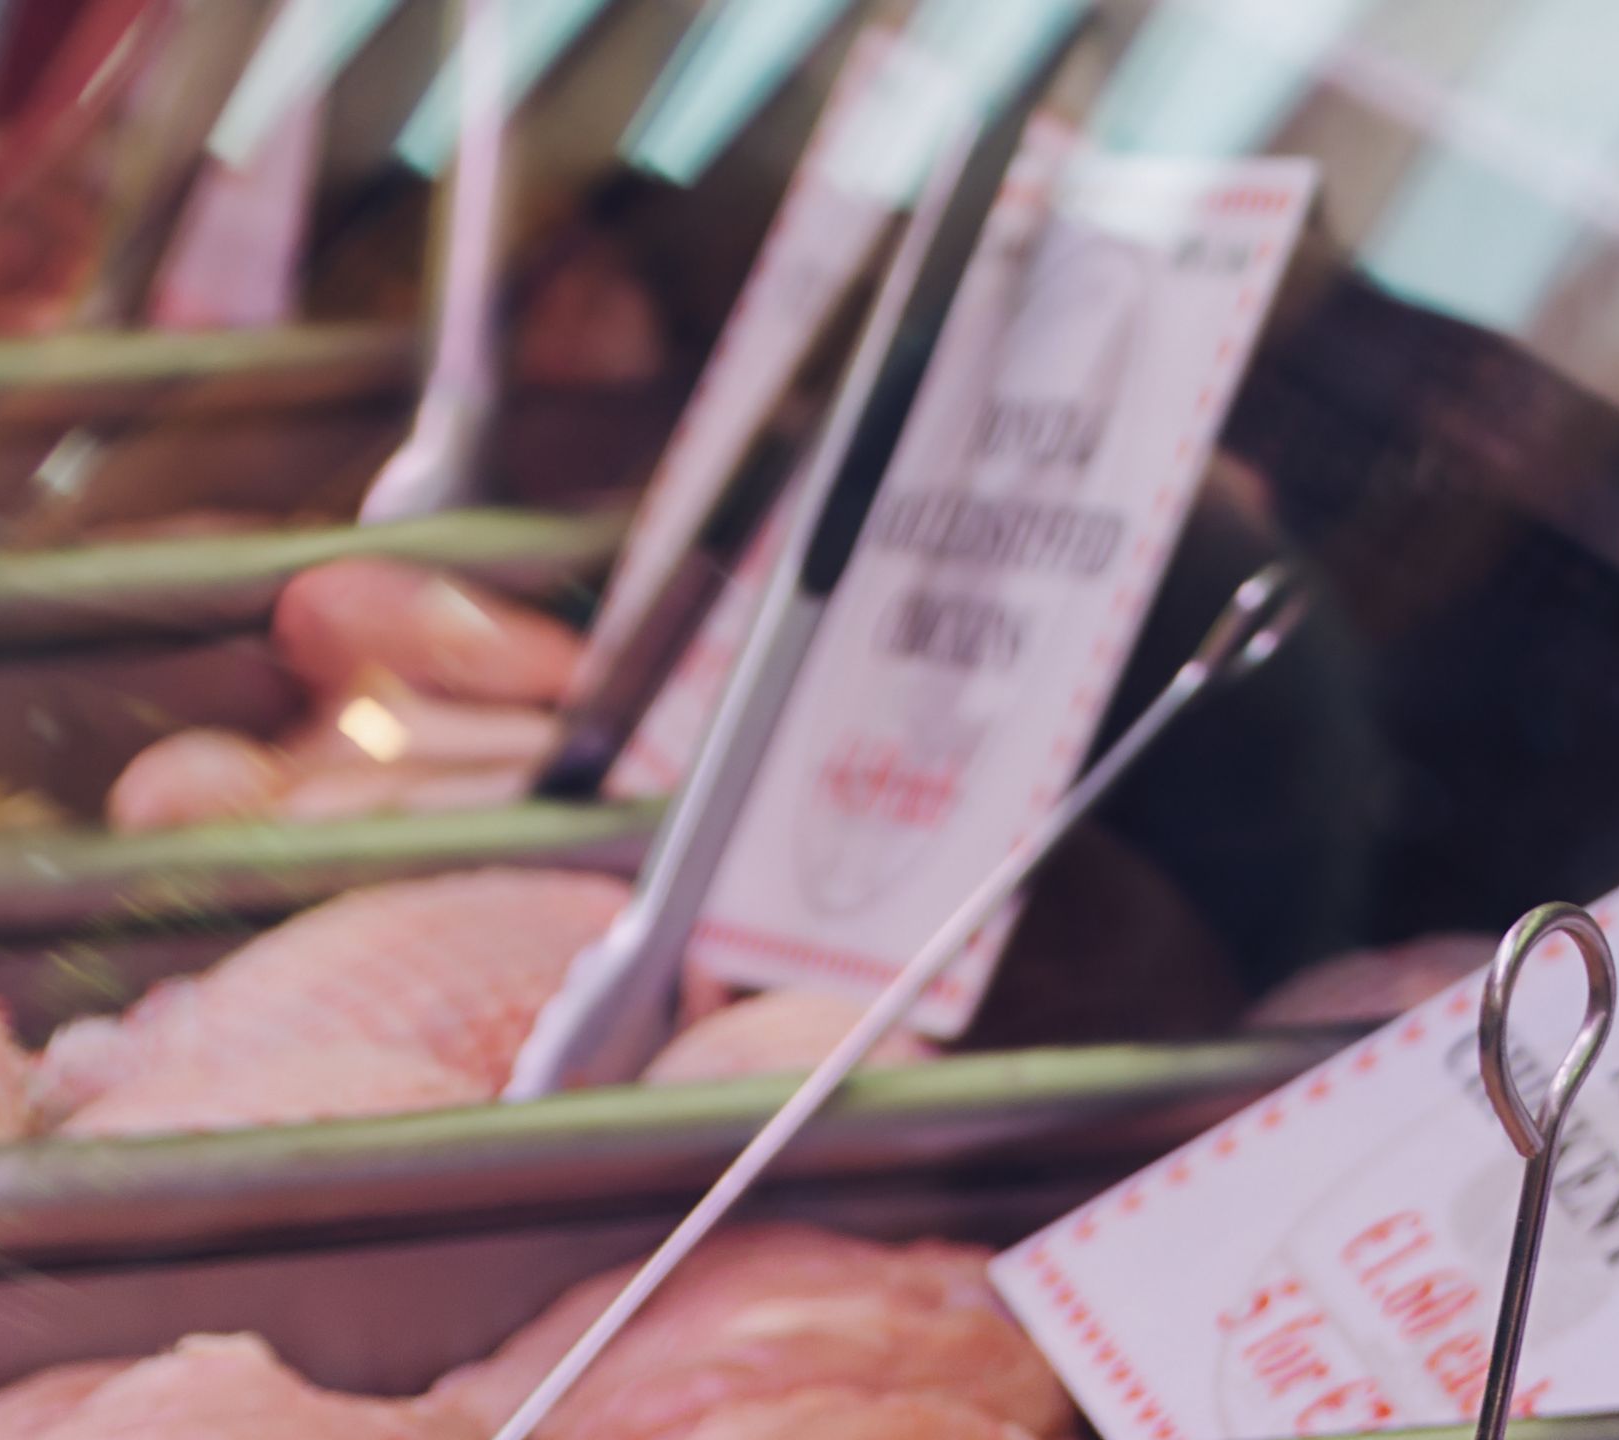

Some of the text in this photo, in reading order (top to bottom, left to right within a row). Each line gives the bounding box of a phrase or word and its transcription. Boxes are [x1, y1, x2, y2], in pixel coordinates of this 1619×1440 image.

[1216, 1276, 1330, 1399] 5 for
[1340, 1209, 1483, 1342] €1.60
